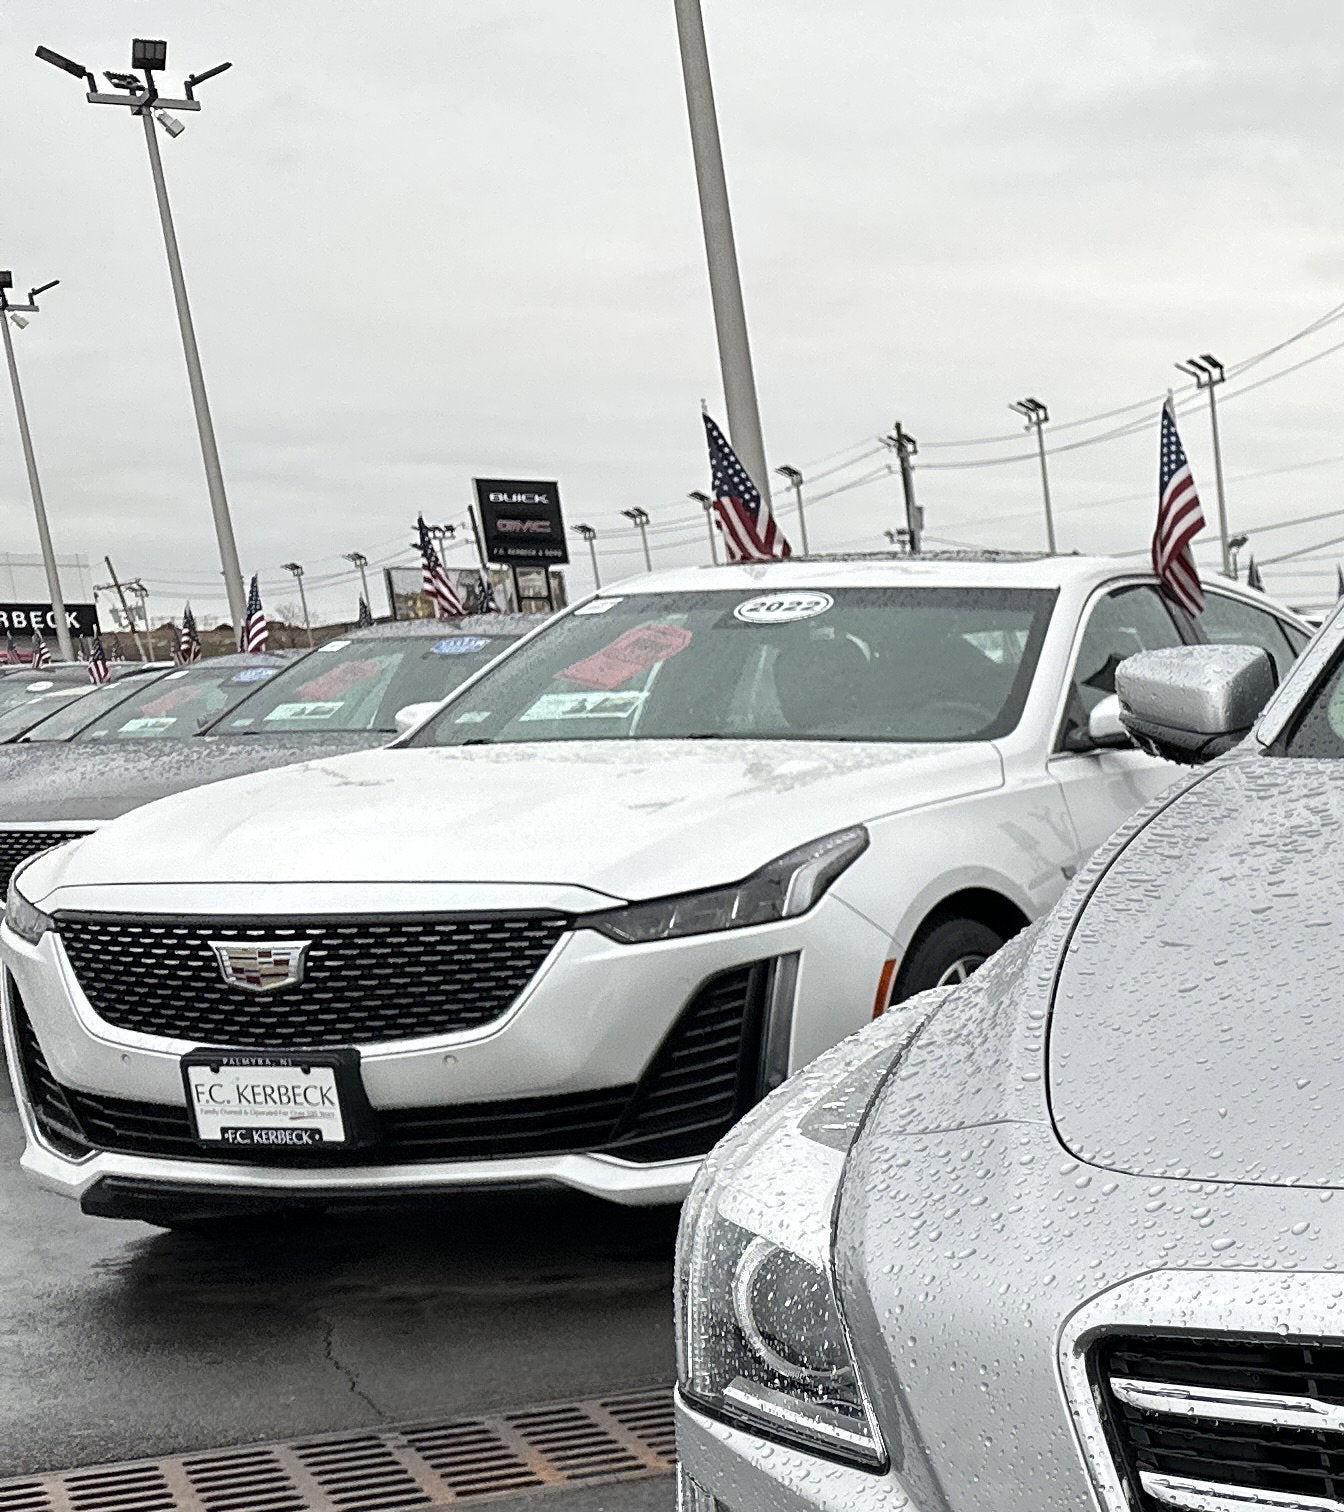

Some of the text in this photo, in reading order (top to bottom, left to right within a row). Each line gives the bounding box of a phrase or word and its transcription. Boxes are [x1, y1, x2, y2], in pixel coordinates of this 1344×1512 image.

[489, 492, 550, 504] BUICK
[496, 519, 551, 533] GMC
[746, 600, 821, 613] 2022
[194, 1083, 336, 1107] F.C. KERBECK
[228, 1129, 312, 1145] F.C. KERBECK
